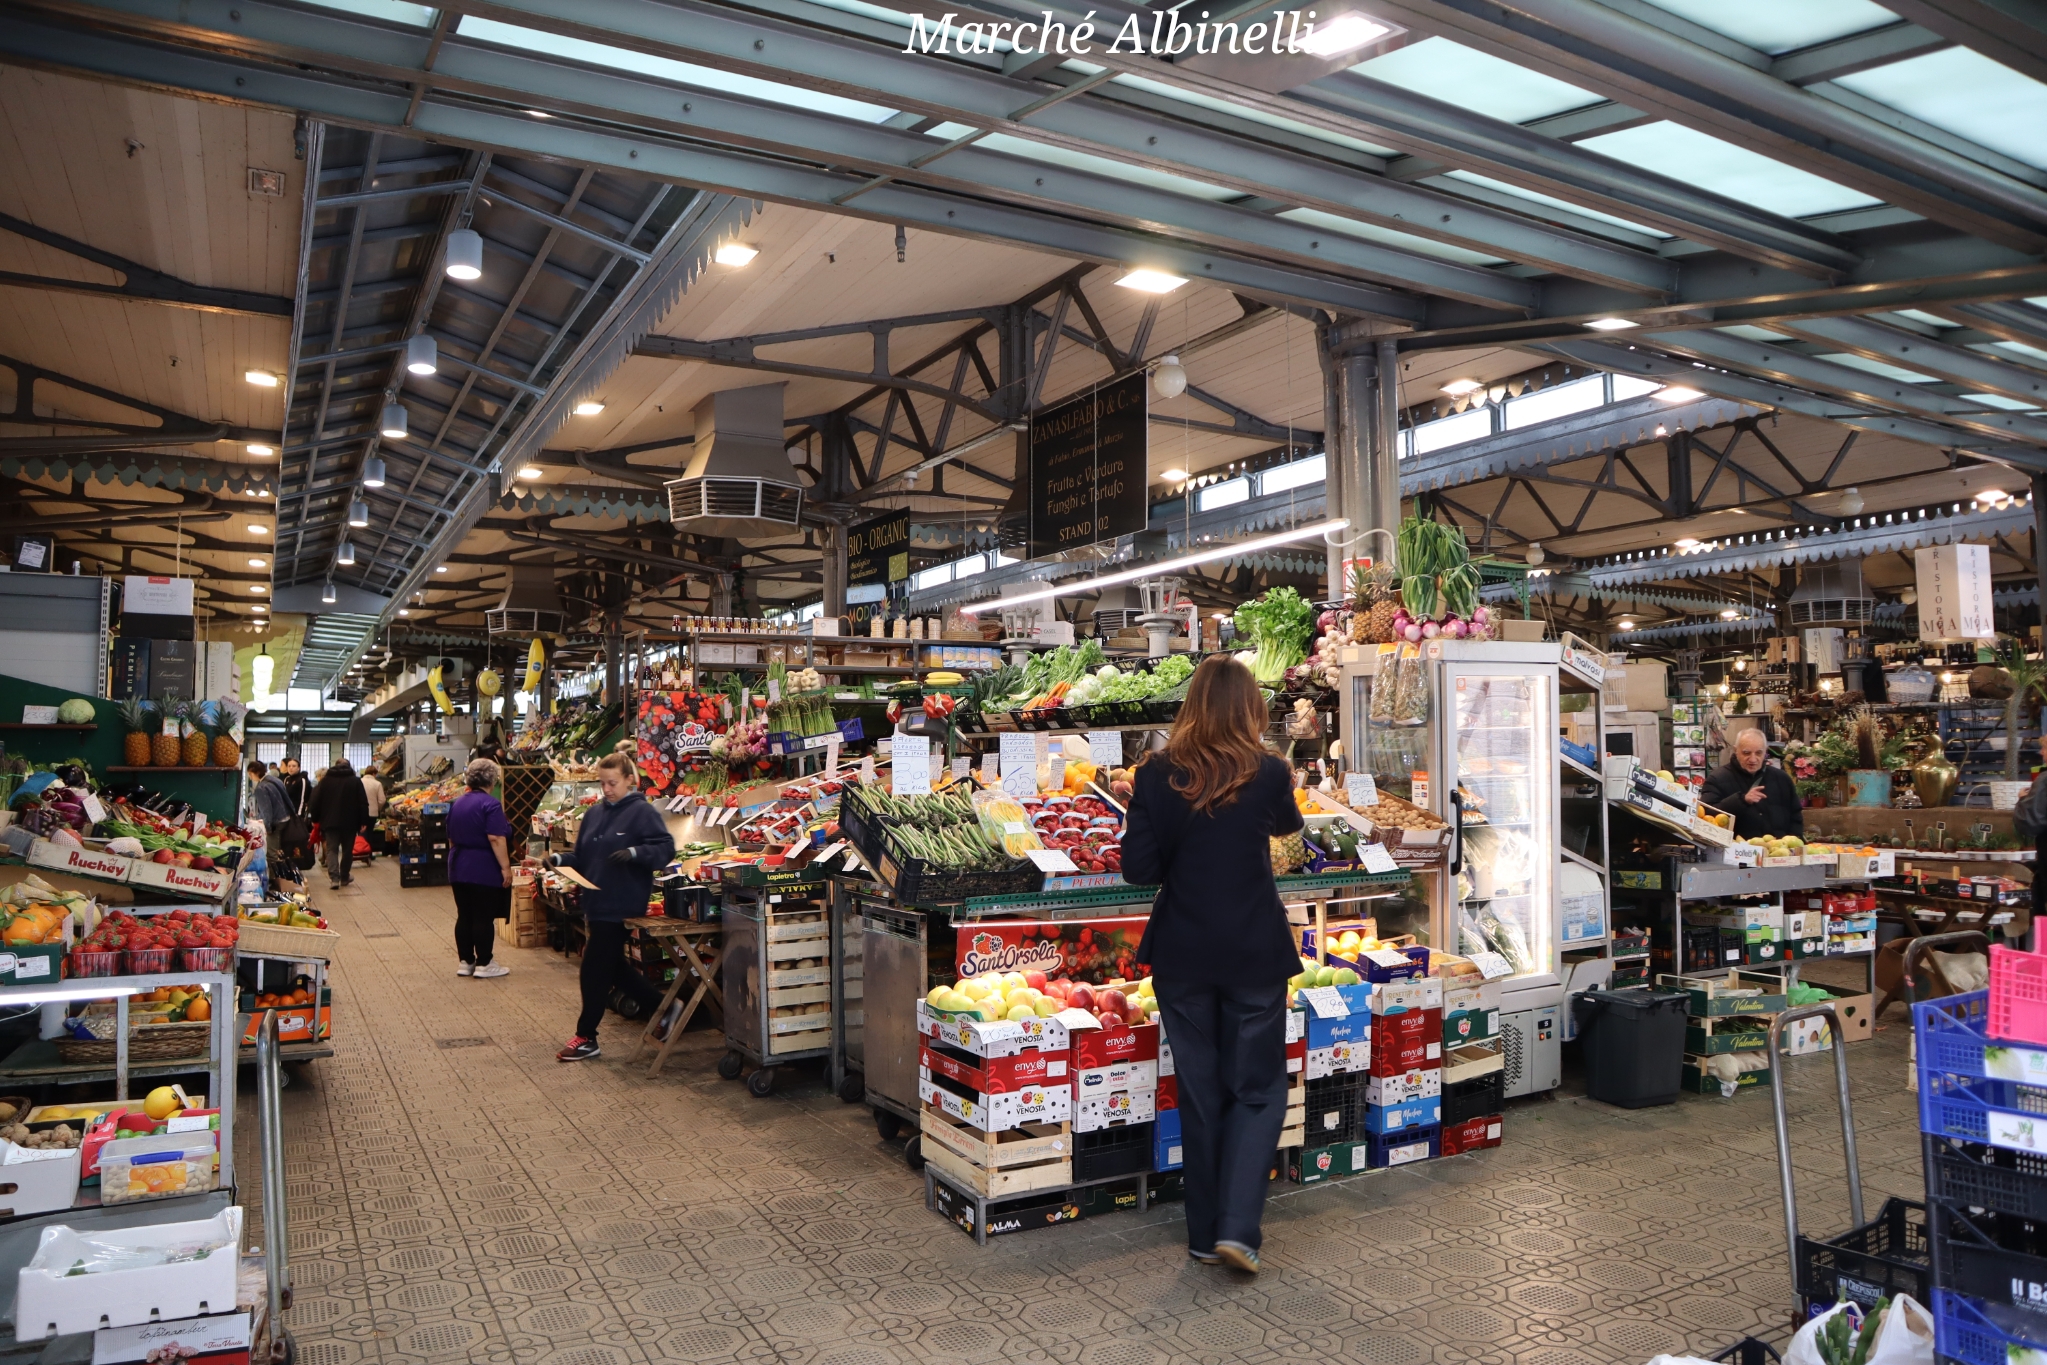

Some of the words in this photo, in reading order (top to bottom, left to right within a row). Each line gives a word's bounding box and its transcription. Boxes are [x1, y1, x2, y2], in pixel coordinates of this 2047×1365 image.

[1047, 475, 1075, 496] Frutta
[1076, 473, 1083, 487] e
[1084, 458, 1124, 483] Verdura
[1047, 493, 1079, 516] Funghi
[1080, 493, 1087, 506] e
[1088, 478, 1124, 503] Tartufo
[848, 533, 863, 557] BIO
[869, 516, 909, 550] ORGANIC
[1059, 520, 1091, 542] STAND
[126, 644, 136, 693] PREMIUM
[1574, 656, 1601, 677] malvasi
[1632, 770, 1656, 788] Melinda
[1628, 793, 1652, 808] Melinda
[767, 872, 795, 882] lapietra
[1730, 998, 1765, 1014] Valentina
[1401, 1018, 1419, 1029] envy
[941, 1030, 959, 1043] VENOSTA
[1014, 1034, 1045, 1044] VENOSTA
[1730, 1035, 1765, 1050] Valentina
[1106, 1037, 1127, 1050] envy
[1401, 1050, 1419, 1060] envy
[943, 1062, 954, 1074] envy
[1015, 1062, 1036, 1074] envy
[1328, 1058, 1352, 1067] VENOSTA
[1737, 1075, 1758, 1086] lentina
[1401, 1085, 1424, 1093] VENOSTA
[943, 1098, 960, 1113] VENOSTA
[1016, 1106, 1046, 1115] VENOSTA
[1103, 1109, 1132, 1119] VENOSTA
[1463, 1127, 1480, 1139] envy
[937, 1188, 952, 1202] ALMA
[991, 1218, 1021, 1232] ALMA
[138, 1321, 209, 1343] topinambur
